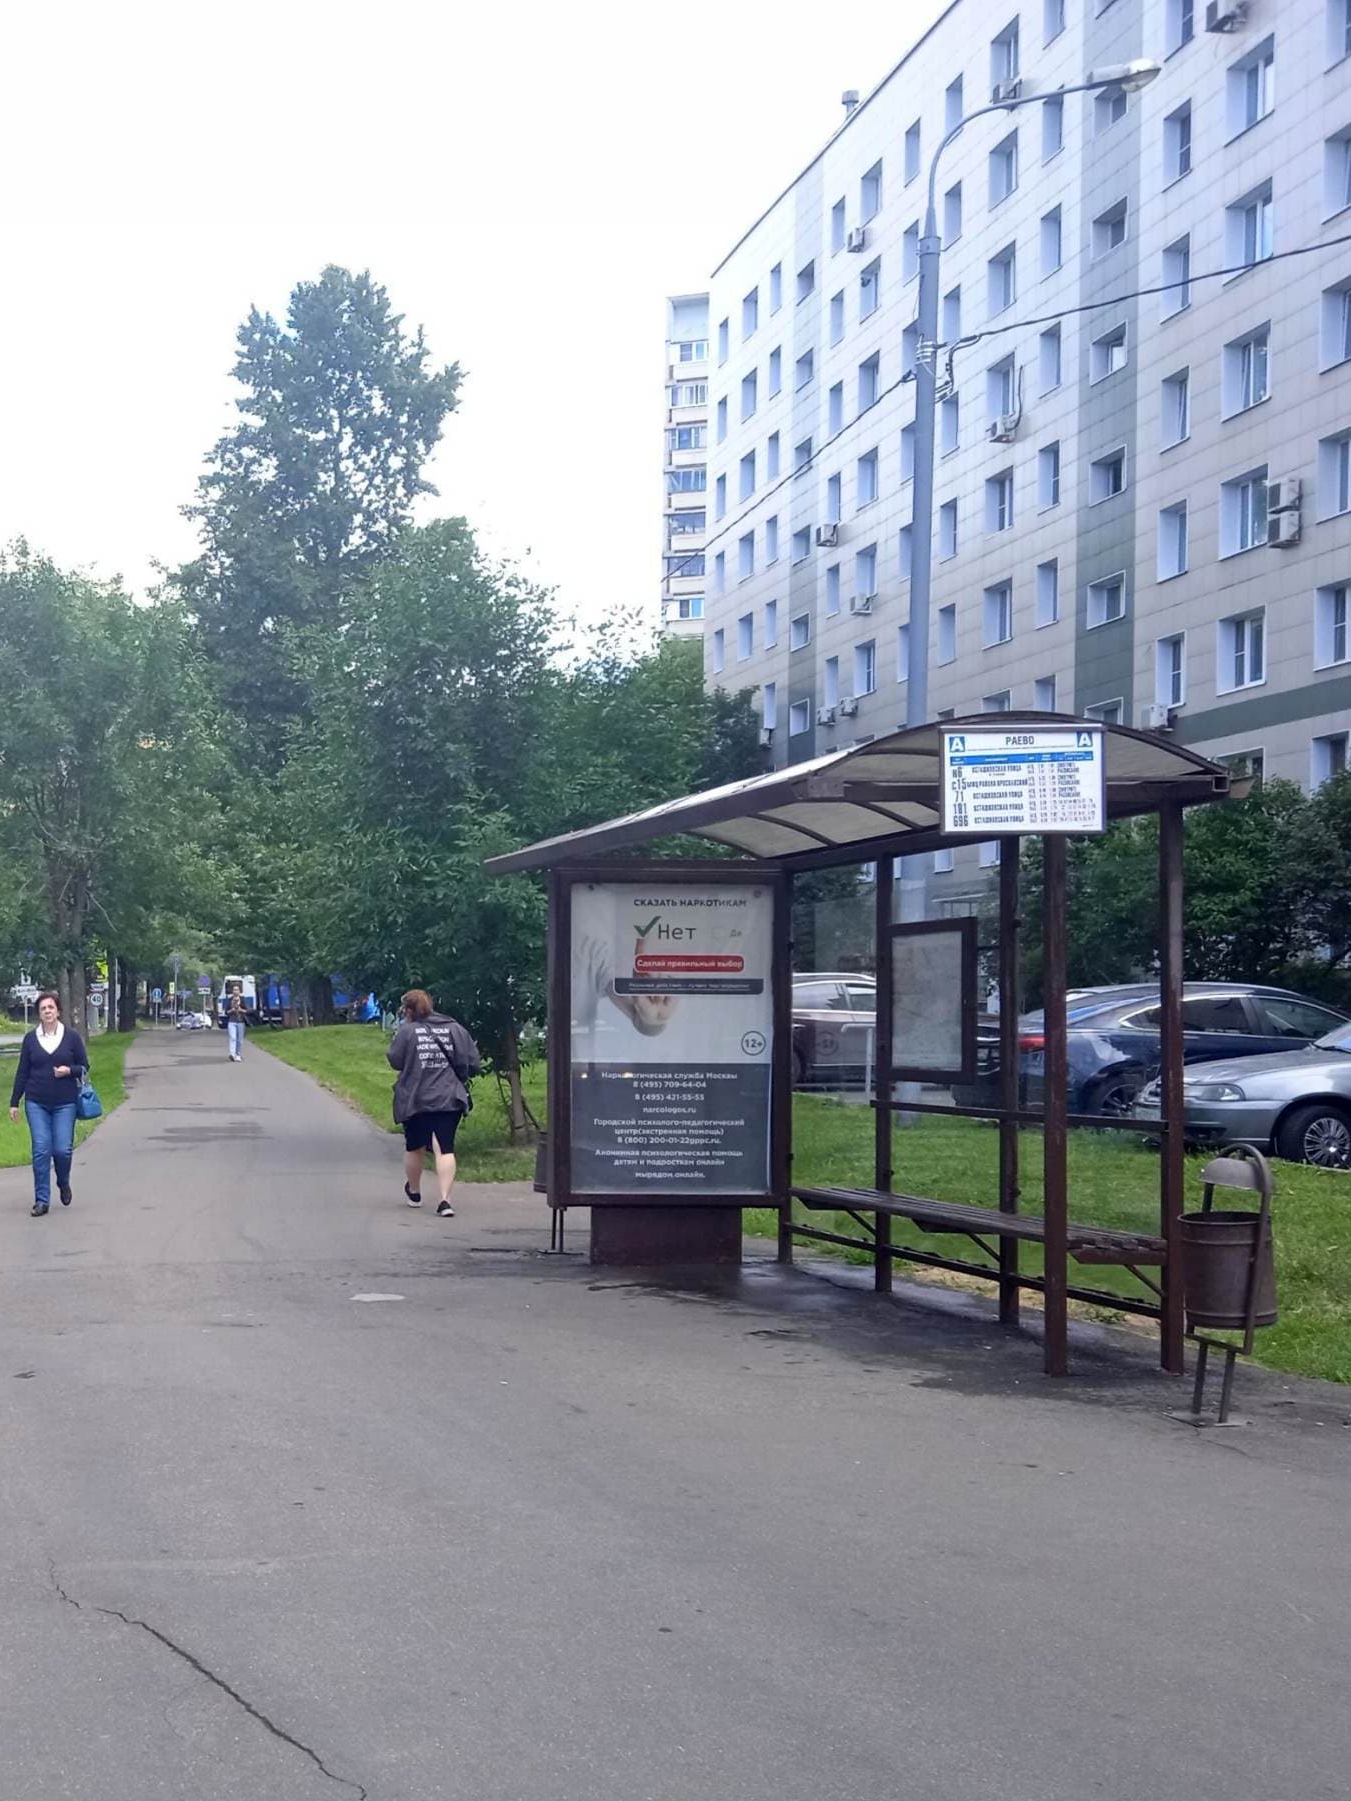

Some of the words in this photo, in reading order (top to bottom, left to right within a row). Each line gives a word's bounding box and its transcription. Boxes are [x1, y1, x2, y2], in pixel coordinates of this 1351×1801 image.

[1005, 735, 1035, 746] РАЕВО
[633, 898, 678, 907] СКАЗАТЬ
[679, 898, 747, 907] НАРКОТИКАМ
[658, 923, 698, 940] Нет
[744, 1037, 764, 1049] 12+
[601, 1071, 672, 1080] Наркогическая
